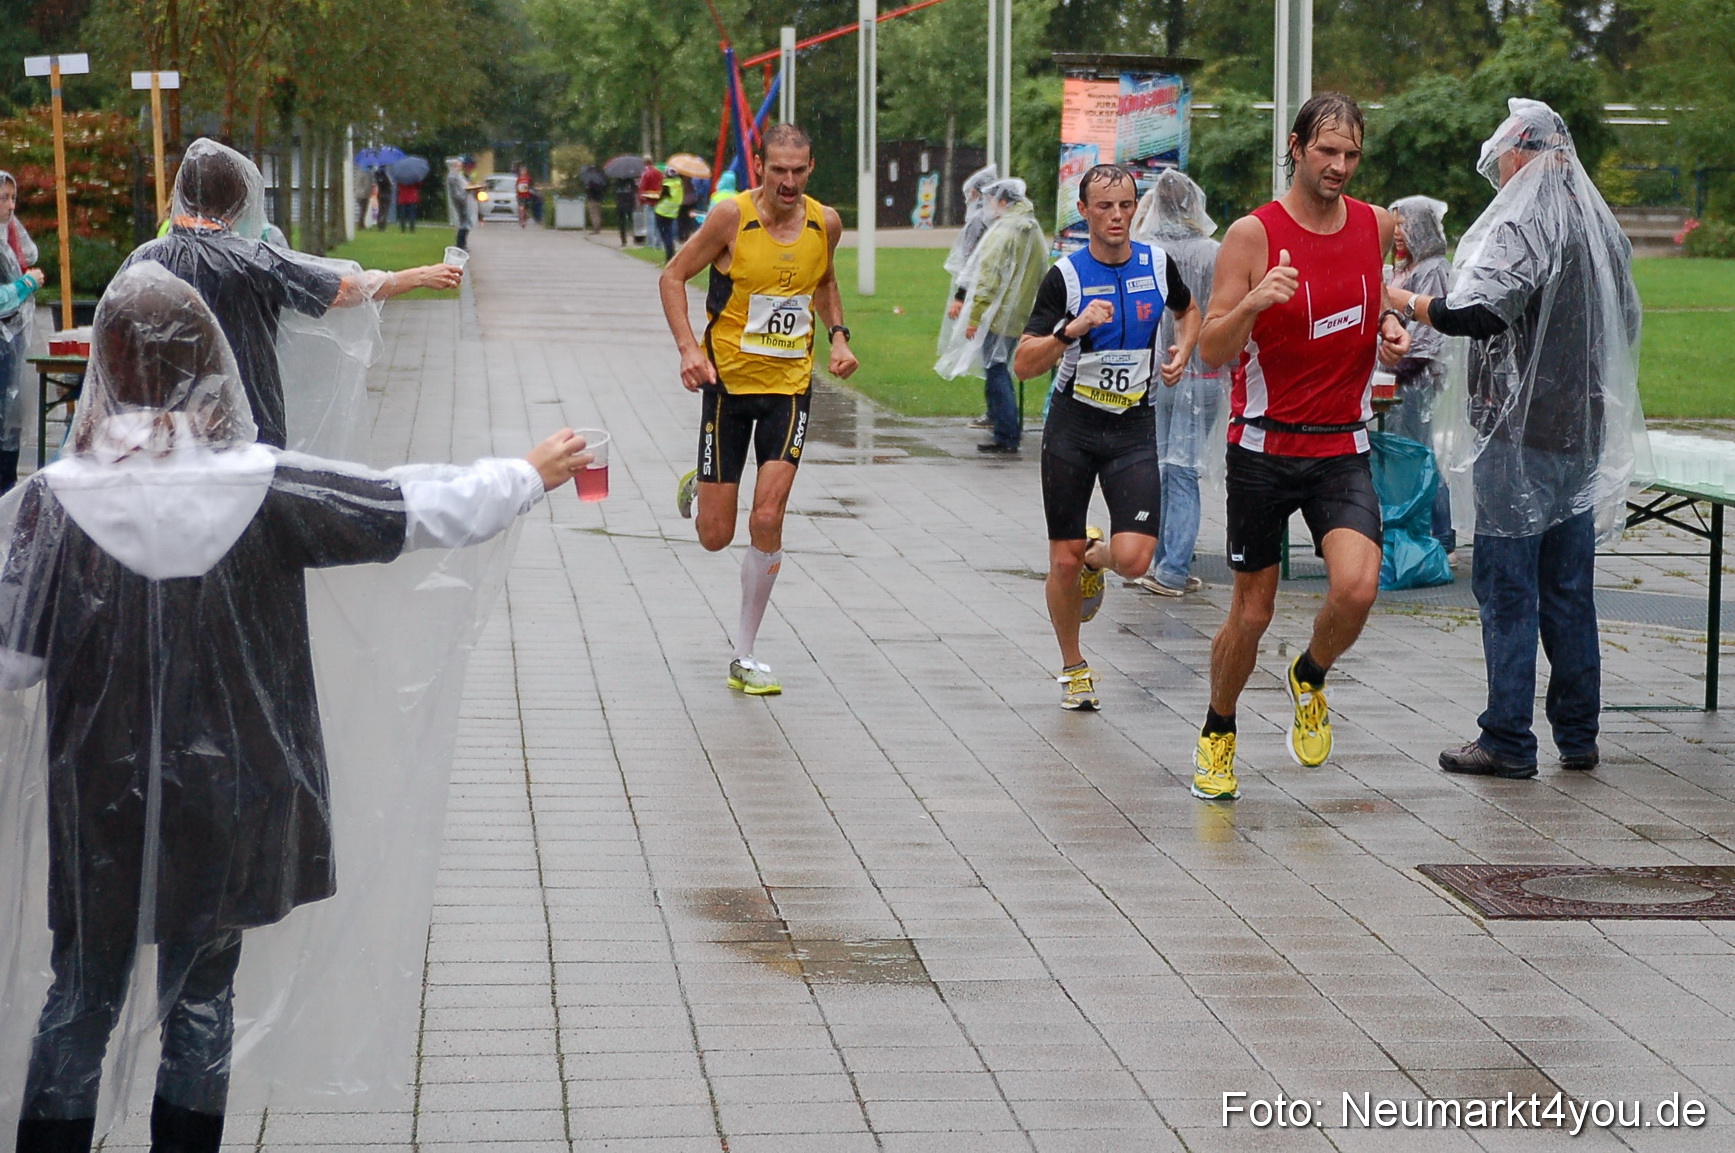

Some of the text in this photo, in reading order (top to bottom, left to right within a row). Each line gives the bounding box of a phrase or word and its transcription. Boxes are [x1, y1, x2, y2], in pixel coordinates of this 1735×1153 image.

[768, 312, 796, 336] 69
[1326, 315, 1349, 329] DEHN
[761, 334, 796, 348] Thomas
[1099, 367, 1130, 393] 36
[1090, 389, 1133, 407] Matthias
